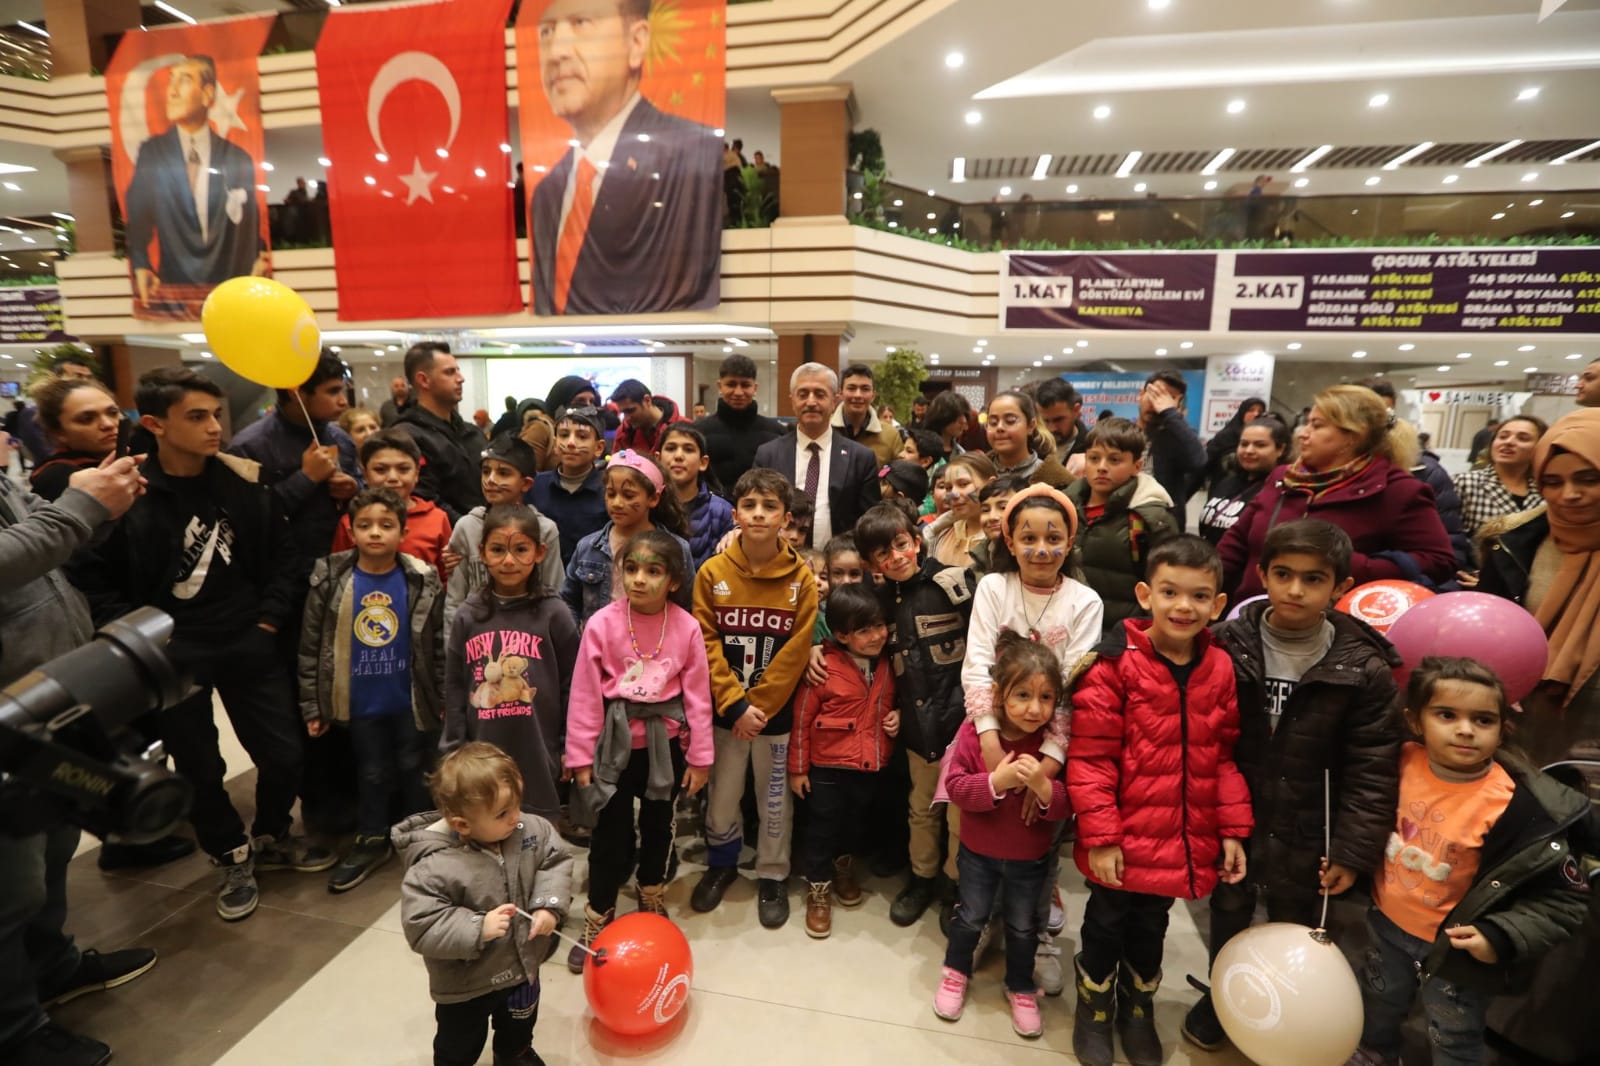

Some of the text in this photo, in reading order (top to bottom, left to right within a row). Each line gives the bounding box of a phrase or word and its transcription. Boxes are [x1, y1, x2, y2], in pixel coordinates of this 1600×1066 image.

[1014, 283, 1068, 299] 1.KAT
[1235, 282, 1299, 299] 2.KAT
[360, 647, 397, 663] REAL
[465, 630, 543, 665] NEW YORK
[497, 705, 532, 717] FRIENDS
